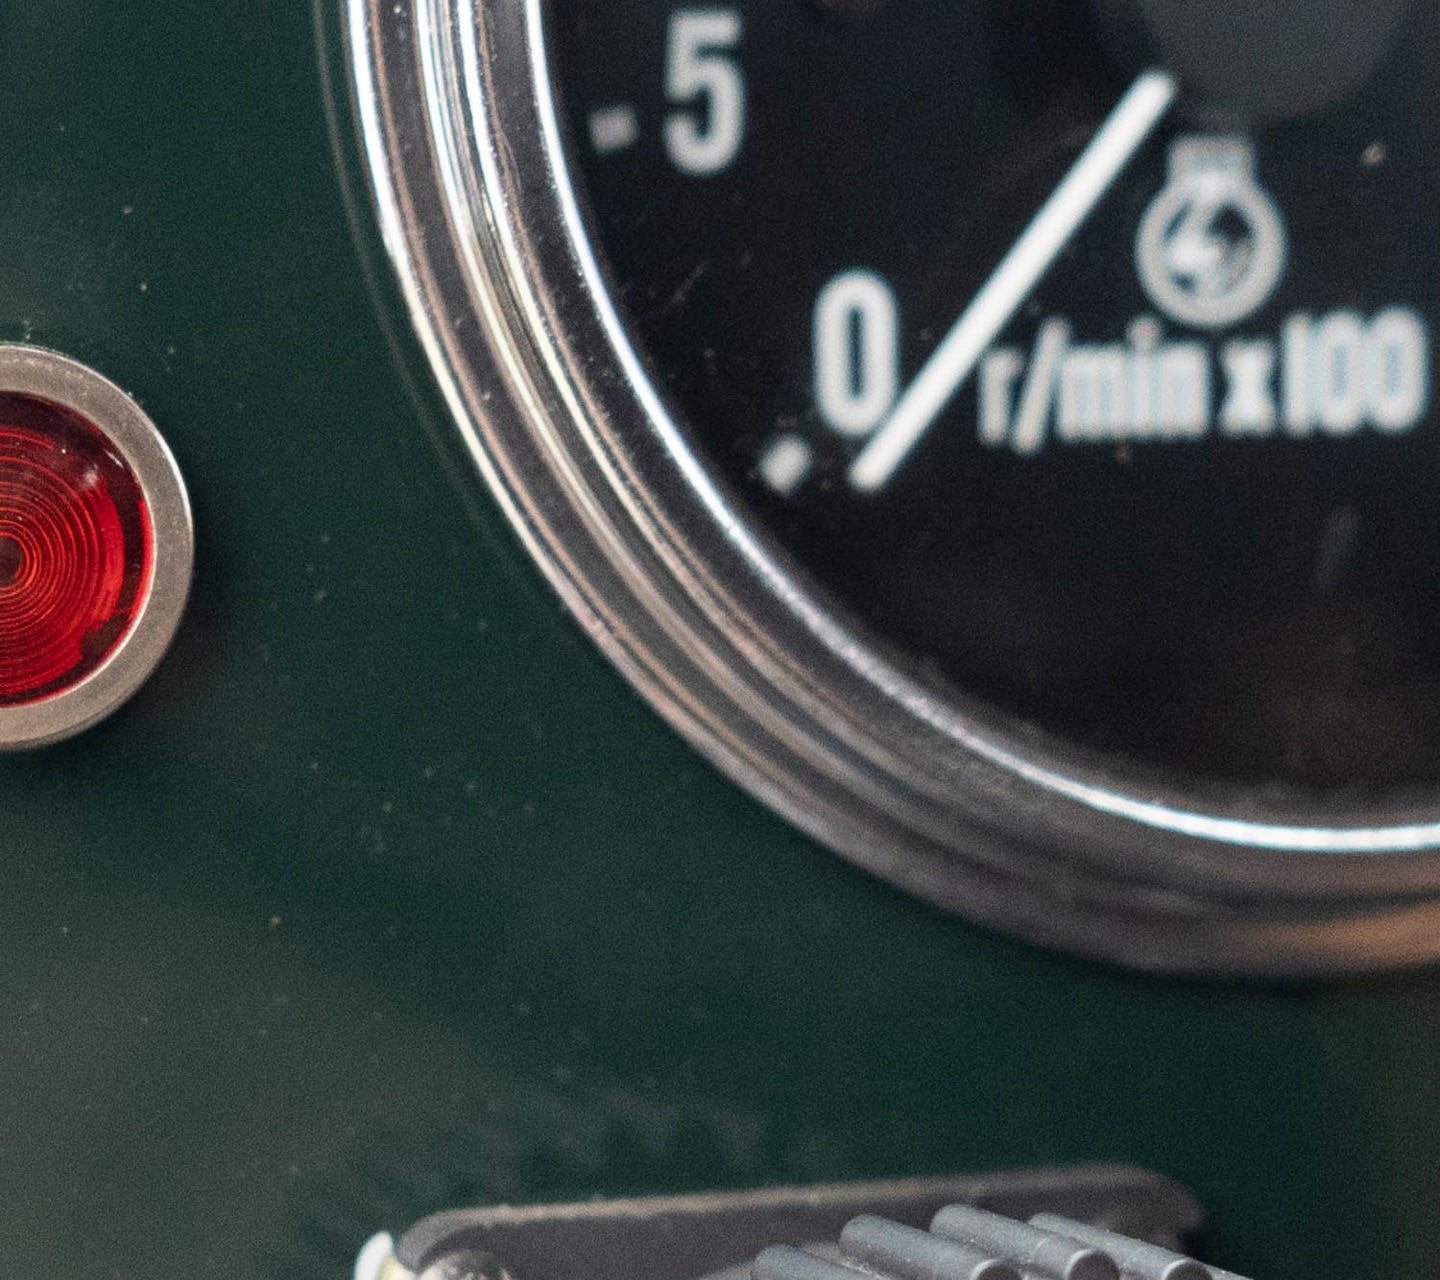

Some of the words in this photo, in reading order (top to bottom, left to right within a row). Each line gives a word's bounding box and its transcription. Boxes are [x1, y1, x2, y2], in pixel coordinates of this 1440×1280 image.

[664, 8, 746, 174] 5
[813, 269, 899, 437] 0
[978, 316, 1211, 454] r/min
